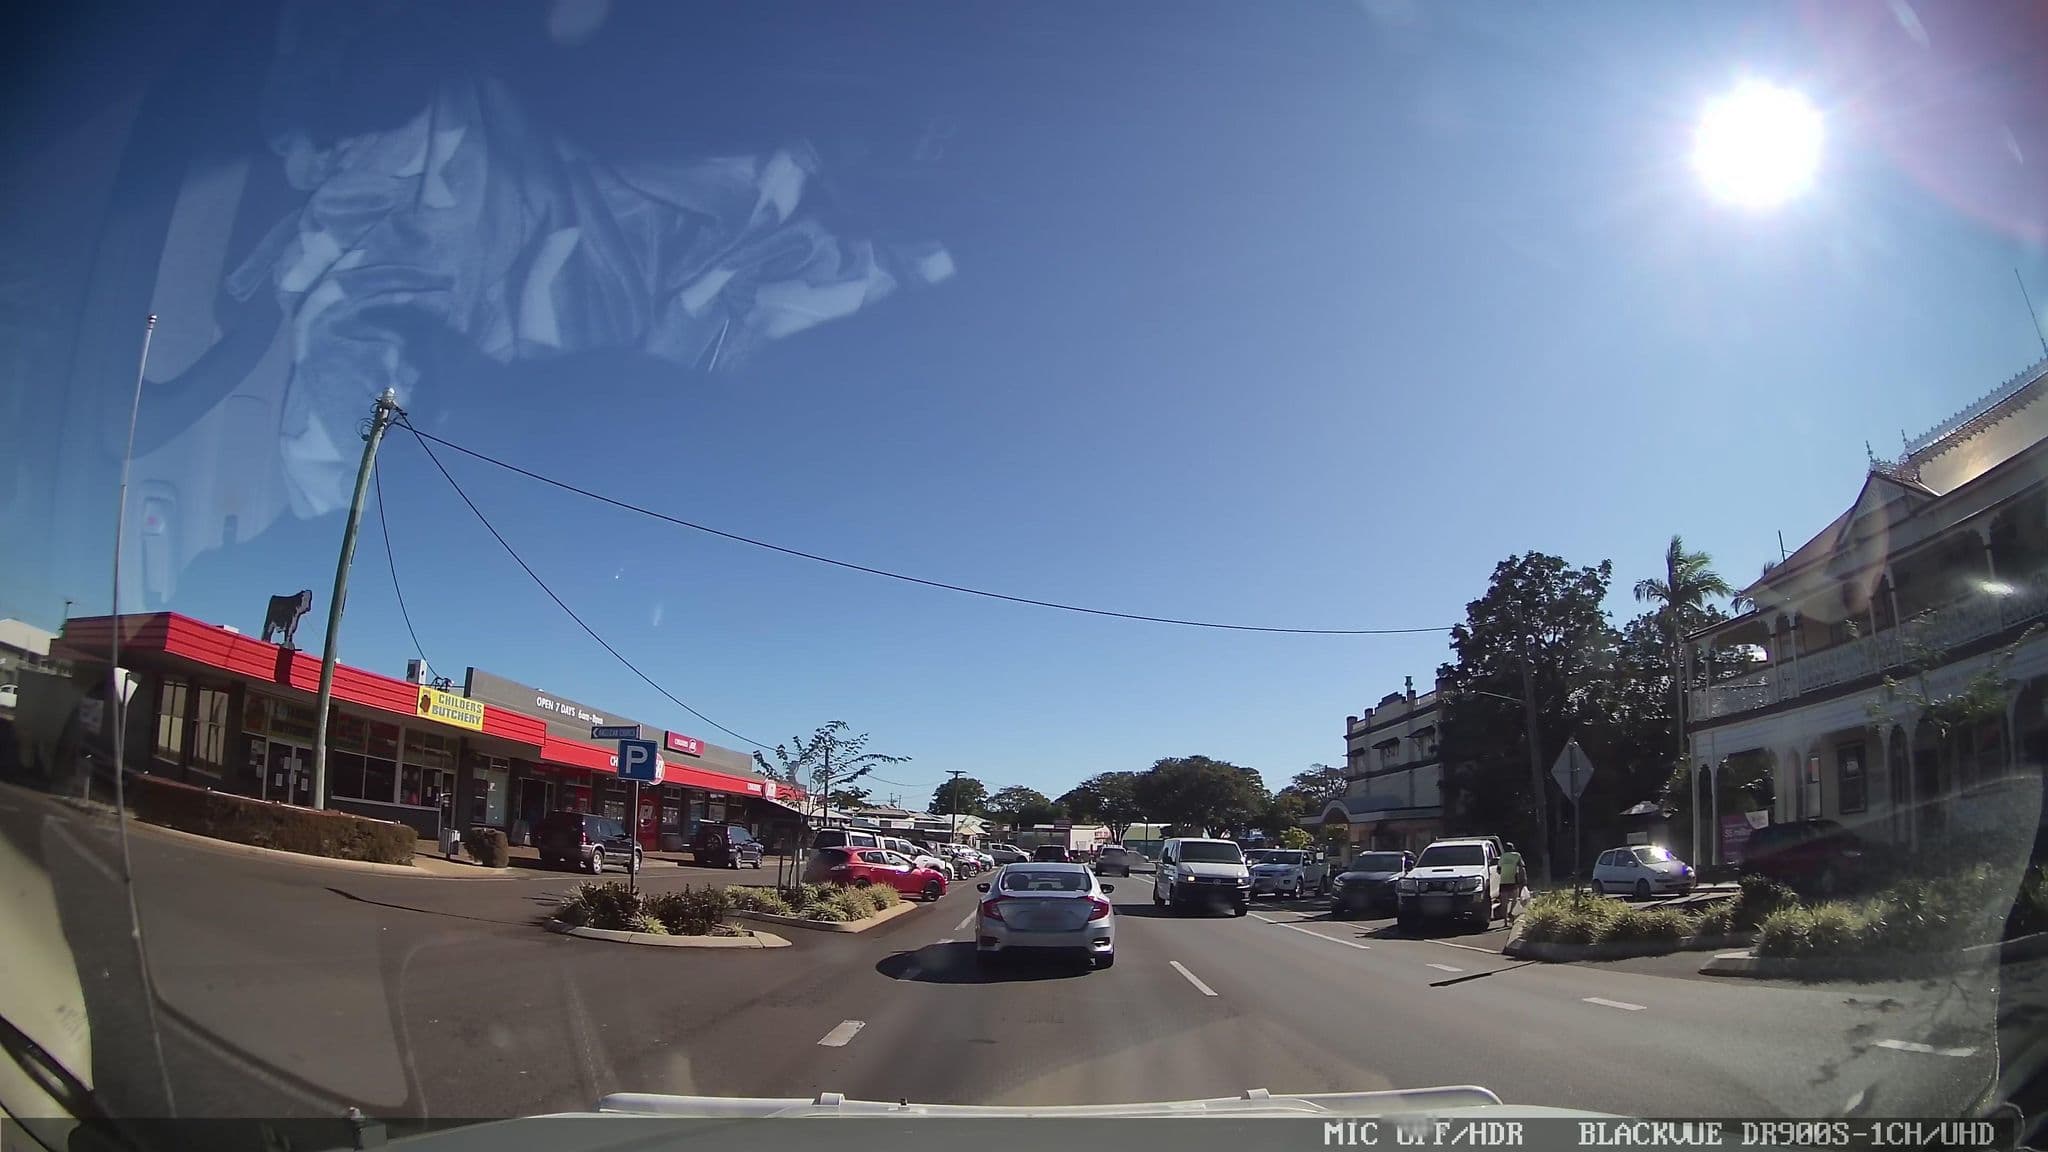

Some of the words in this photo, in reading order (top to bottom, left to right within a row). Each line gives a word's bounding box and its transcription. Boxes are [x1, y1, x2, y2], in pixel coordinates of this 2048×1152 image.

[439, 693, 482, 714] CHILDERS
[536, 696, 554, 711] OPEN
[555, 702, 560, 712] 7
[560, 703, 576, 717] DAYS
[432, 705, 481, 725] BUTCHERY
[625, 745, 648, 774] P
